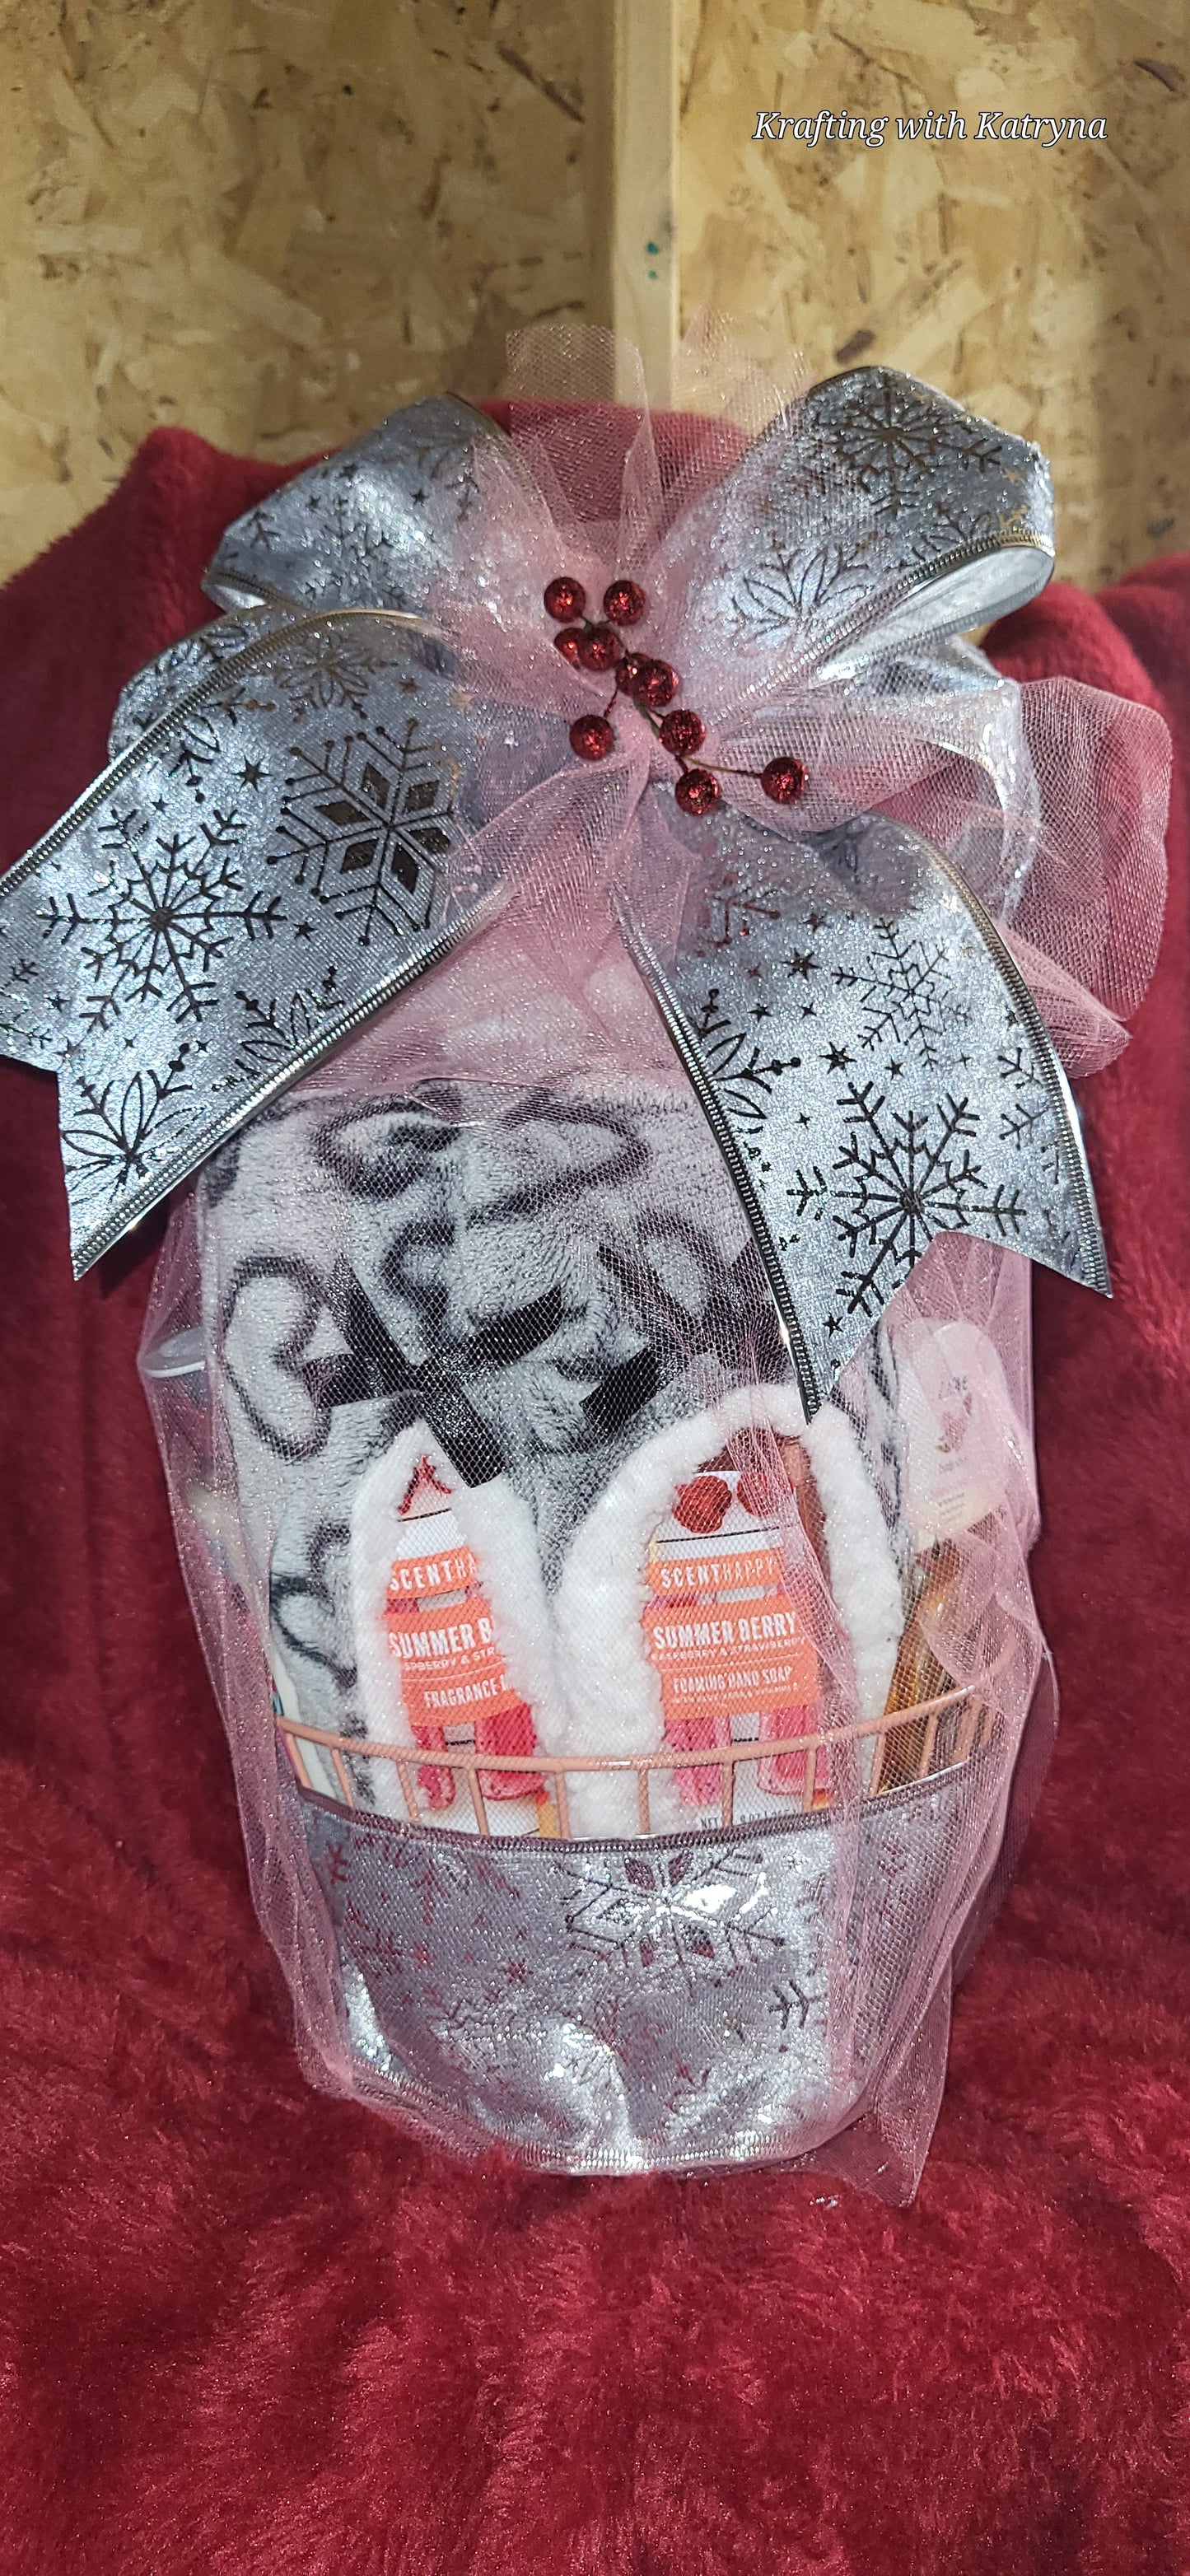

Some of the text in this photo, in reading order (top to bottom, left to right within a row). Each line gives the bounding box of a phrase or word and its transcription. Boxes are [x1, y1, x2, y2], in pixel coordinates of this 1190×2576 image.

[390, 1553, 478, 1591] SCENTHA
[660, 1556, 773, 1589] SCENTHAPPY
[389, 1623, 476, 1659] SUMMER
[653, 1611, 796, 1650] SUMMER BERRY
[404, 1658, 457, 1671] SPBERRY
[673, 1673, 726, 1694] FOAMING
[728, 1670, 760, 1688] HAND
[762, 1665, 793, 1684] SOAP
[423, 1678, 497, 1709] FRAGRANCE
